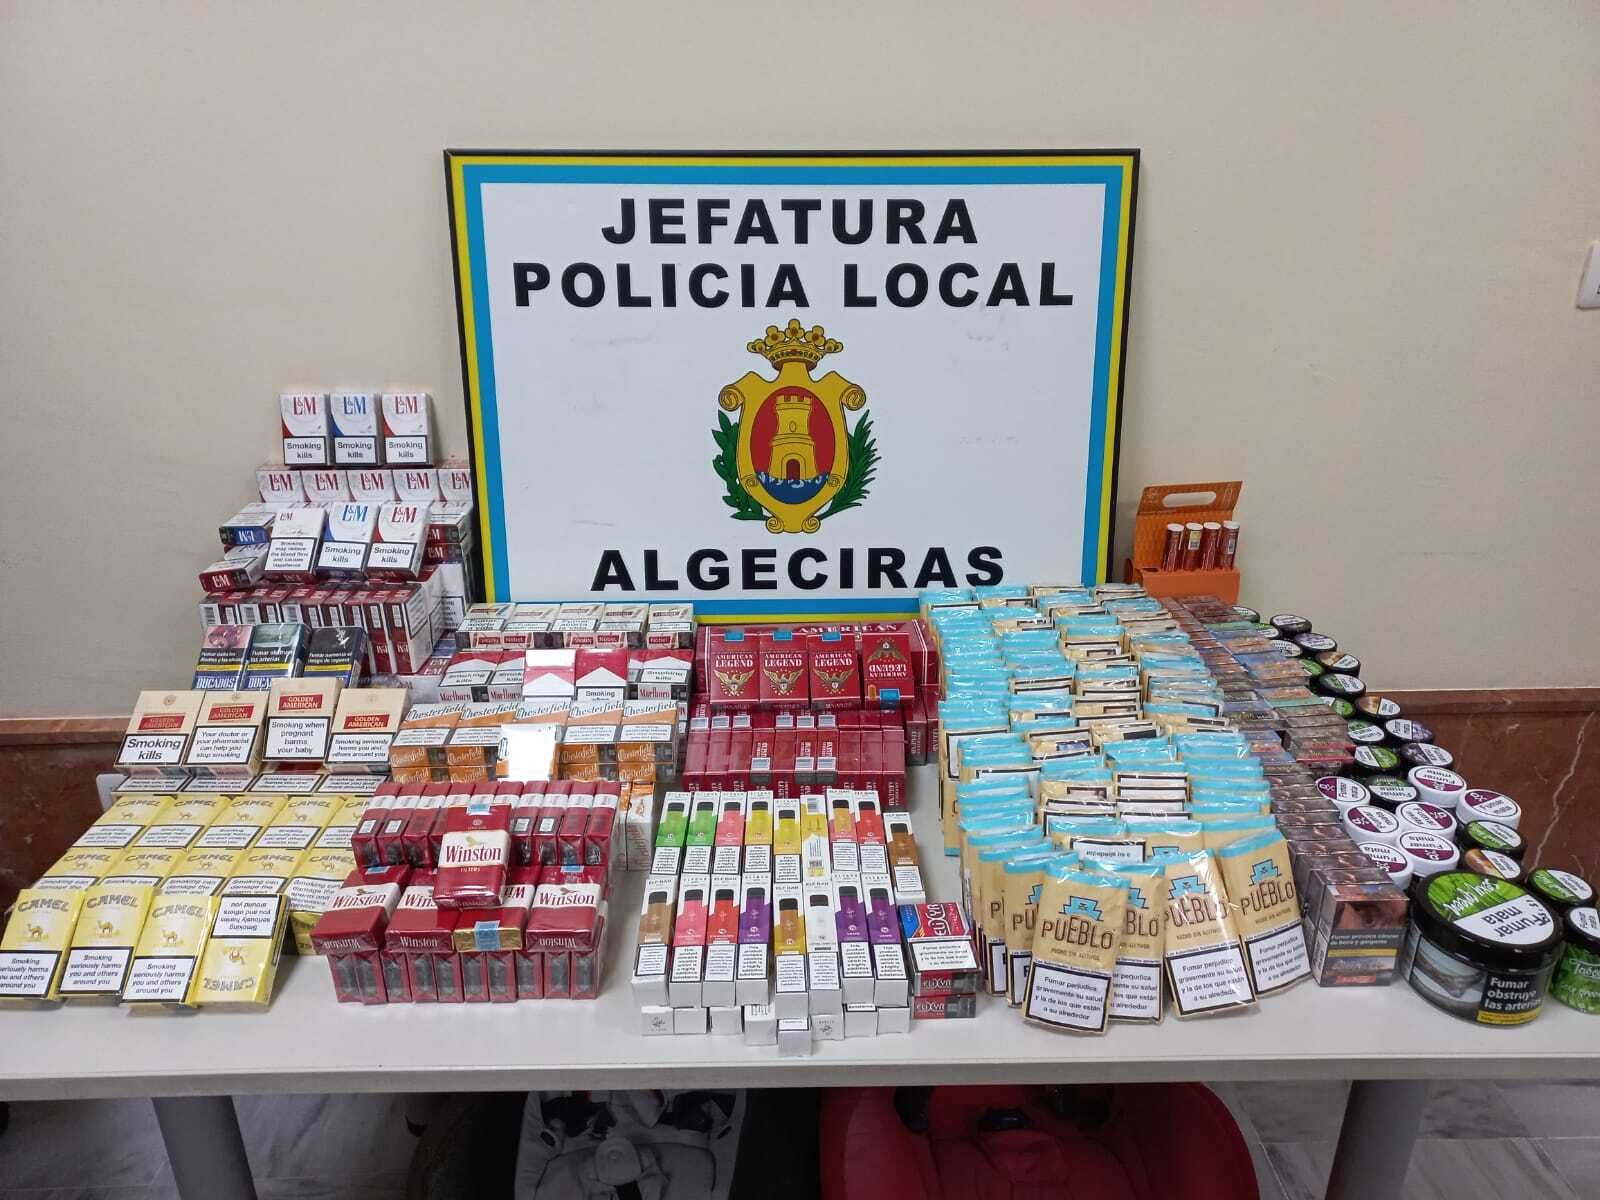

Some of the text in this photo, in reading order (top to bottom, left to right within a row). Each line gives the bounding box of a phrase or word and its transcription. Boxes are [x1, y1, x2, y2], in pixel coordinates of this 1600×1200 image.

[601, 198, 978, 245] JEFATURA
[512, 260, 1075, 309] POLICIA LOCAL
[293, 396, 317, 416] L&M
[343, 396, 367, 416] L&M
[395, 396, 418, 416] L&M
[287, 441, 322, 451] Smoking
[337, 441, 372, 451] Smoking
[388, 441, 423, 450] Smoking
[297, 450, 313, 459] kills
[347, 450, 363, 459] kills
[398, 450, 414, 459] kills
[324, 547, 362, 556] Smoking
[374, 547, 410, 556] Smoking
[332, 556, 349, 564] kills
[381, 555, 398, 564] kills
[590, 546, 1005, 593] ALGECIRAS
[715, 659, 754, 668] LEGEND
[764, 659, 803, 668] LEGEND
[815, 658, 853, 667] LEGEND
[639, 686, 671, 699] Marlboro
[407, 704, 466, 721] Chesterfield
[461, 703, 519, 720] Chesterfield
[516, 700, 572, 719] Chesterfield
[569, 701, 624, 718] Chesterfield
[272, 721, 325, 730] Smoking when
[280, 730, 314, 738] pregnant
[127, 738, 181, 750] Smoking
[138, 750, 163, 760] kills
[277, 746, 313, 755] your baby
[445, 843, 502, 864] Winston
[86, 894, 139, 909] CAMEL
[332, 893, 387, 909] Winston
[539, 892, 595, 906] Winston
[1240, 880, 1295, 917] PUEBLO
[17, 898, 70, 913] CAMEL
[152, 905, 206, 919] CAMEL
[1481, 905, 1524, 926] mata
[1126, 909, 1159, 938] BLO
[1494, 910, 1552, 938] Fumar
[1041, 914, 1115, 951] PUEBLO
[400, 936, 438, 948] Winston
[539, 938, 577, 948] Winston
[11, 957, 41, 966] Smoking
[83, 954, 113, 962] Smoking
[71, 962, 99, 970] seriously
[147, 963, 177, 971] Smoking
[132, 979, 145, 987] you
[159, 978, 182, 986] others
[1043, 976, 1097, 992] Fumar perjudica
[1489, 976, 1530, 989] Fumar
[135, 986, 160, 994] around
[1035, 985, 1075, 998] gravemente
[1085, 995, 1104, 1003] salud
[1487, 989, 1537, 1001] obstruye
[1484, 1000, 1503, 1010] las
[1058, 1009, 1091, 1021] alrededor
